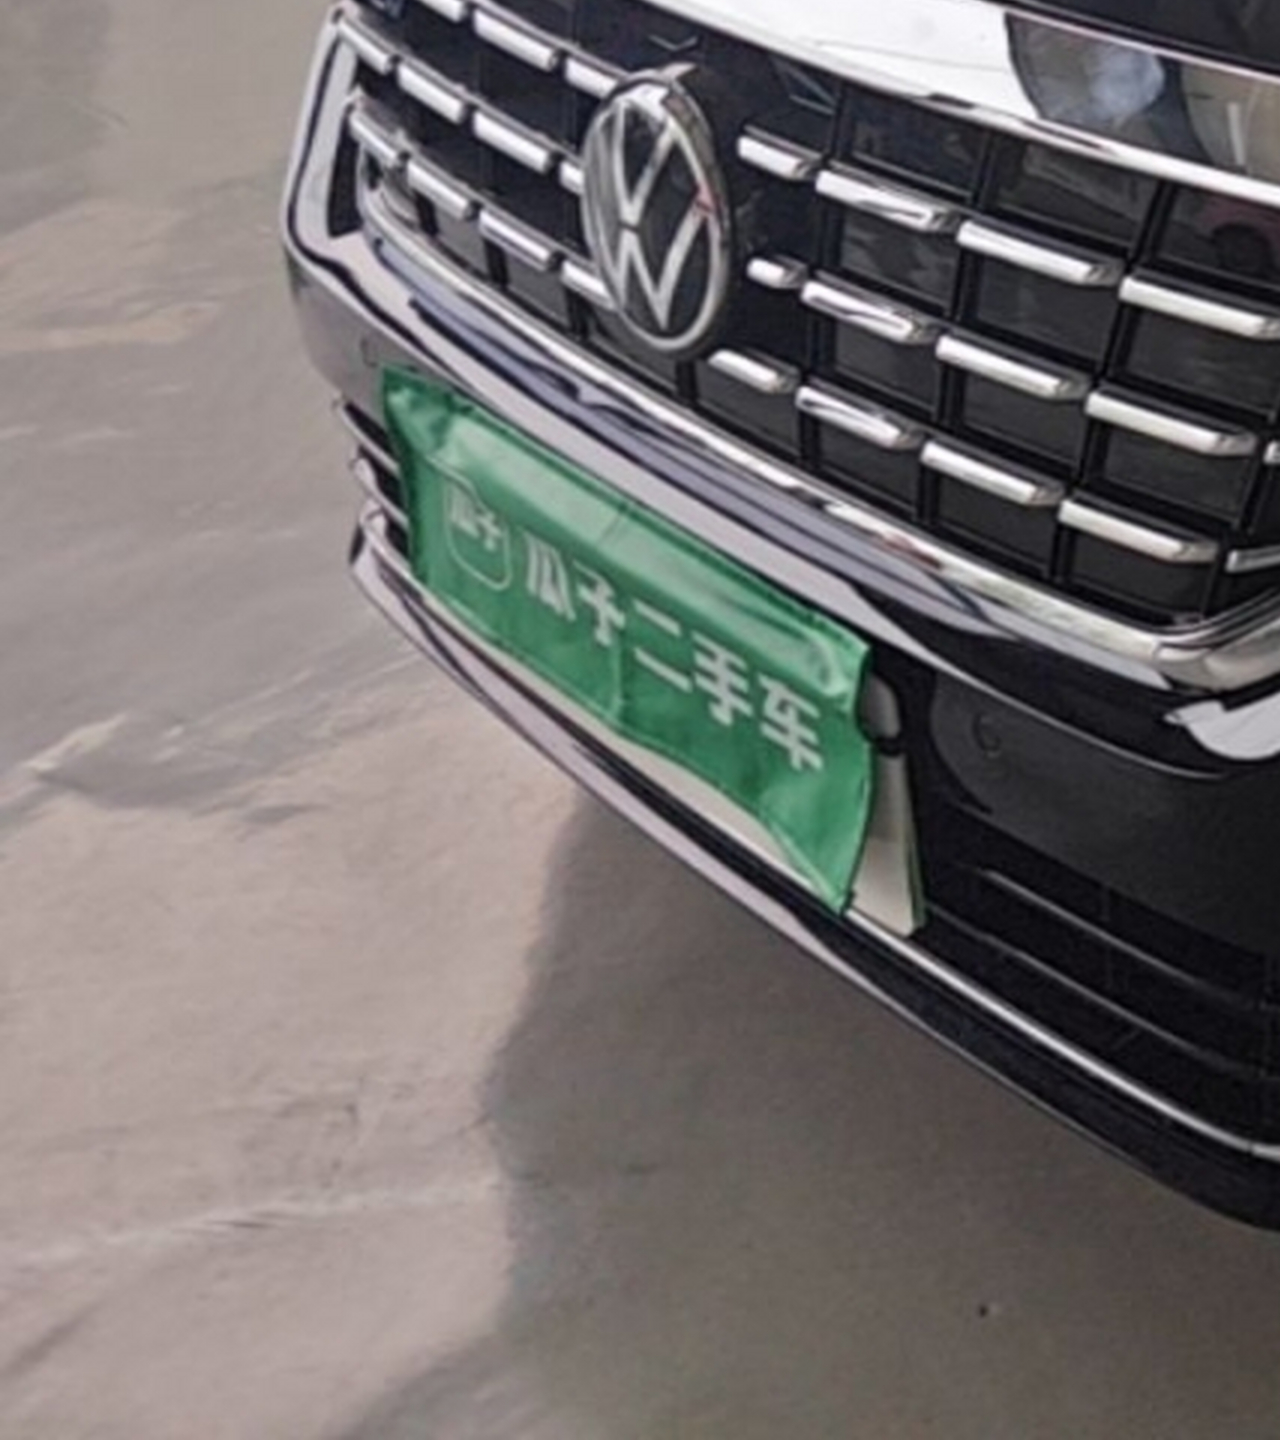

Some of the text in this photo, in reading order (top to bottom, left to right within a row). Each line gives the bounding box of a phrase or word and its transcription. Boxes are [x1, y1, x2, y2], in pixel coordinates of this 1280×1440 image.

[524, 529, 824, 772] 瓜子二手车
